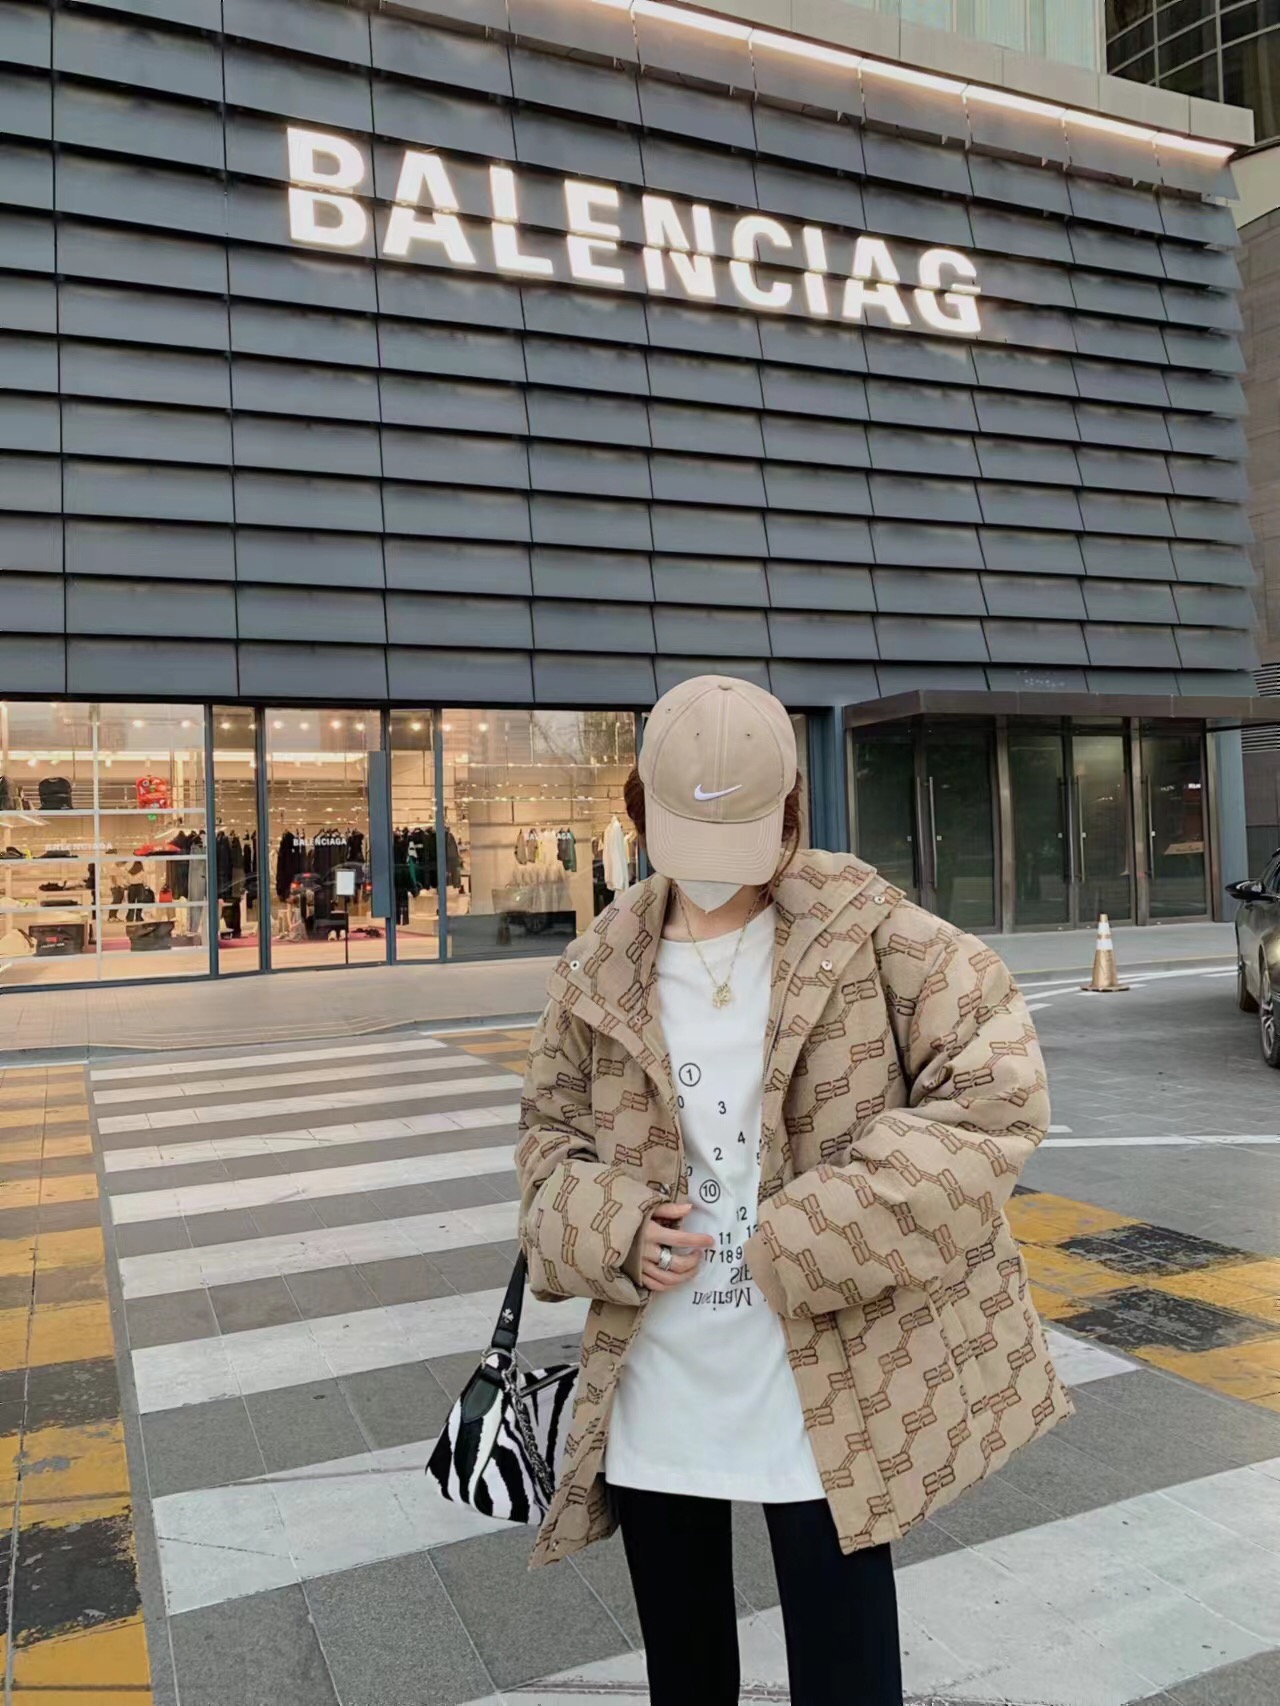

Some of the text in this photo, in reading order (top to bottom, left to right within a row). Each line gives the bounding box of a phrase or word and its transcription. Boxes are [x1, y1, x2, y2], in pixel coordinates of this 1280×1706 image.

[286, 126, 982, 334] BALENCIAG
[293, 838, 347, 847] BALENCIAGA
[718, 1101, 727, 1115] 3
[737, 1131, 746, 1144] 4
[713, 1147, 723, 1161] 2
[719, 1232, 731, 1245] 11
[719, 1250, 734, 1264] 18
